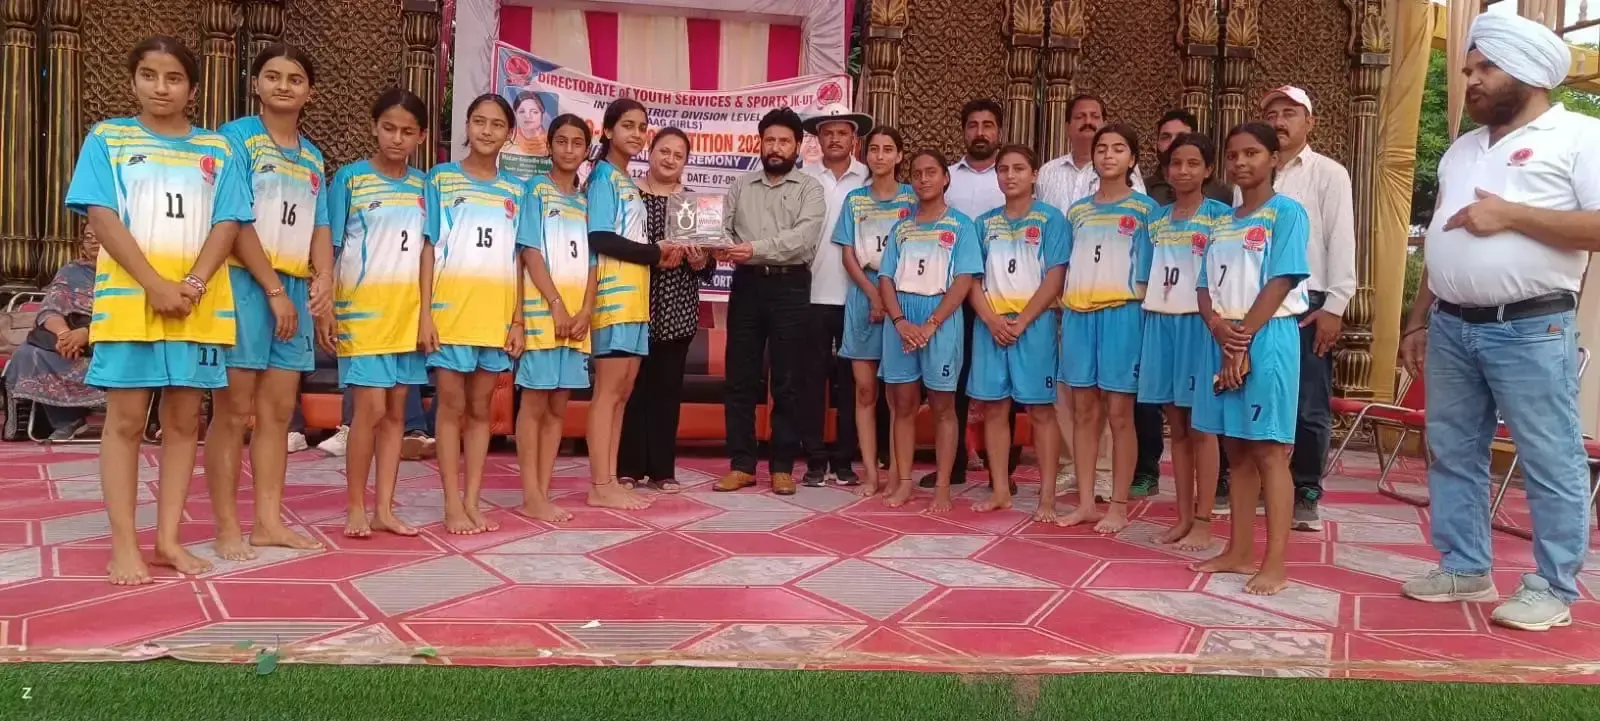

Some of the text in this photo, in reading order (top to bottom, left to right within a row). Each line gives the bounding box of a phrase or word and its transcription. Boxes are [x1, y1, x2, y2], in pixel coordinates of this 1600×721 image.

[538, 72, 615, 98] DIRECTORATE
[633, 88, 671, 105] YOUTH
[675, 94, 731, 108] SERVICES
[735, 95, 743, 108] &
[747, 95, 788, 108] SPORTS
[790, 94, 814, 107] JK-UT
[681, 110, 728, 121] DIVISION
[731, 112, 762, 122] LEVEL
[738, 134, 762, 153] 202
[688, 155, 741, 167] REMONY
[687, 173, 710, 184] DATE:
[166, 192, 185, 218] 11
[281, 201, 296, 227] 16
[401, 230, 408, 252] 2
[476, 226, 493, 248] 15
[569, 240, 578, 259] 3
[1094, 245, 1102, 263] 5
[917, 259, 925, 276] 5
[1008, 258, 1016, 274] 8
[1163, 266, 1179, 287] 10
[1218, 264, 1228, 288] 7
[199, 347, 218, 367] 11
[941, 364, 950, 377] 5
[1045, 375, 1053, 389] 8
[1251, 404, 1262, 422] 7
